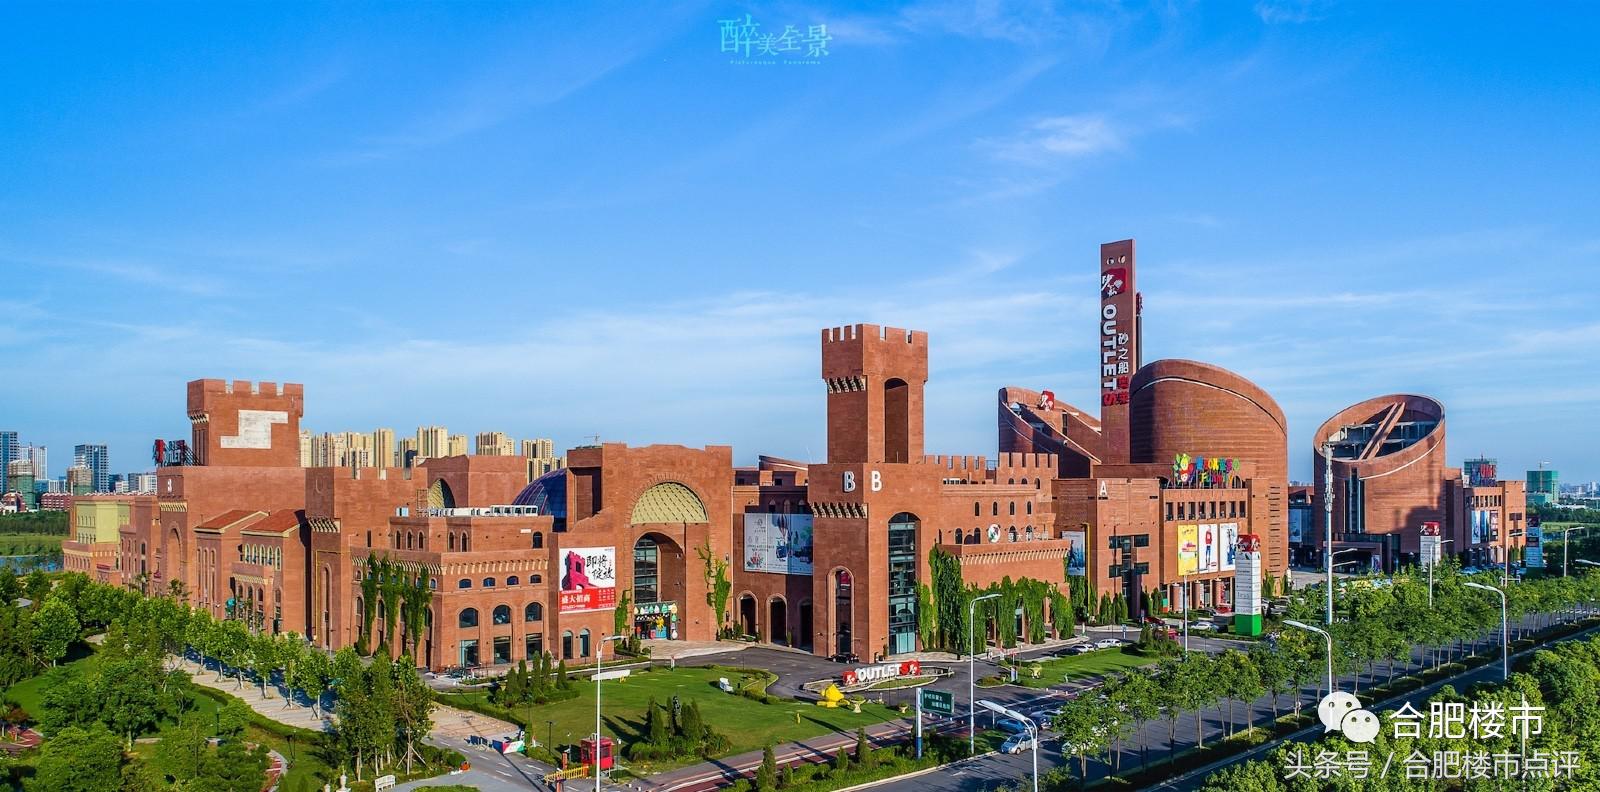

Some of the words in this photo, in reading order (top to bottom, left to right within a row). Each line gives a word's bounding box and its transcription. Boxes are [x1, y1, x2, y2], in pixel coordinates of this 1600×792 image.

[1102, 304, 1117, 406] OUTLETS
[843, 471, 856, 493] B
[871, 470, 883, 492] B
[1099, 480, 1108, 496] A
[586, 555, 608, 567] 即将
[855, 663, 909, 682] OUTLETS
